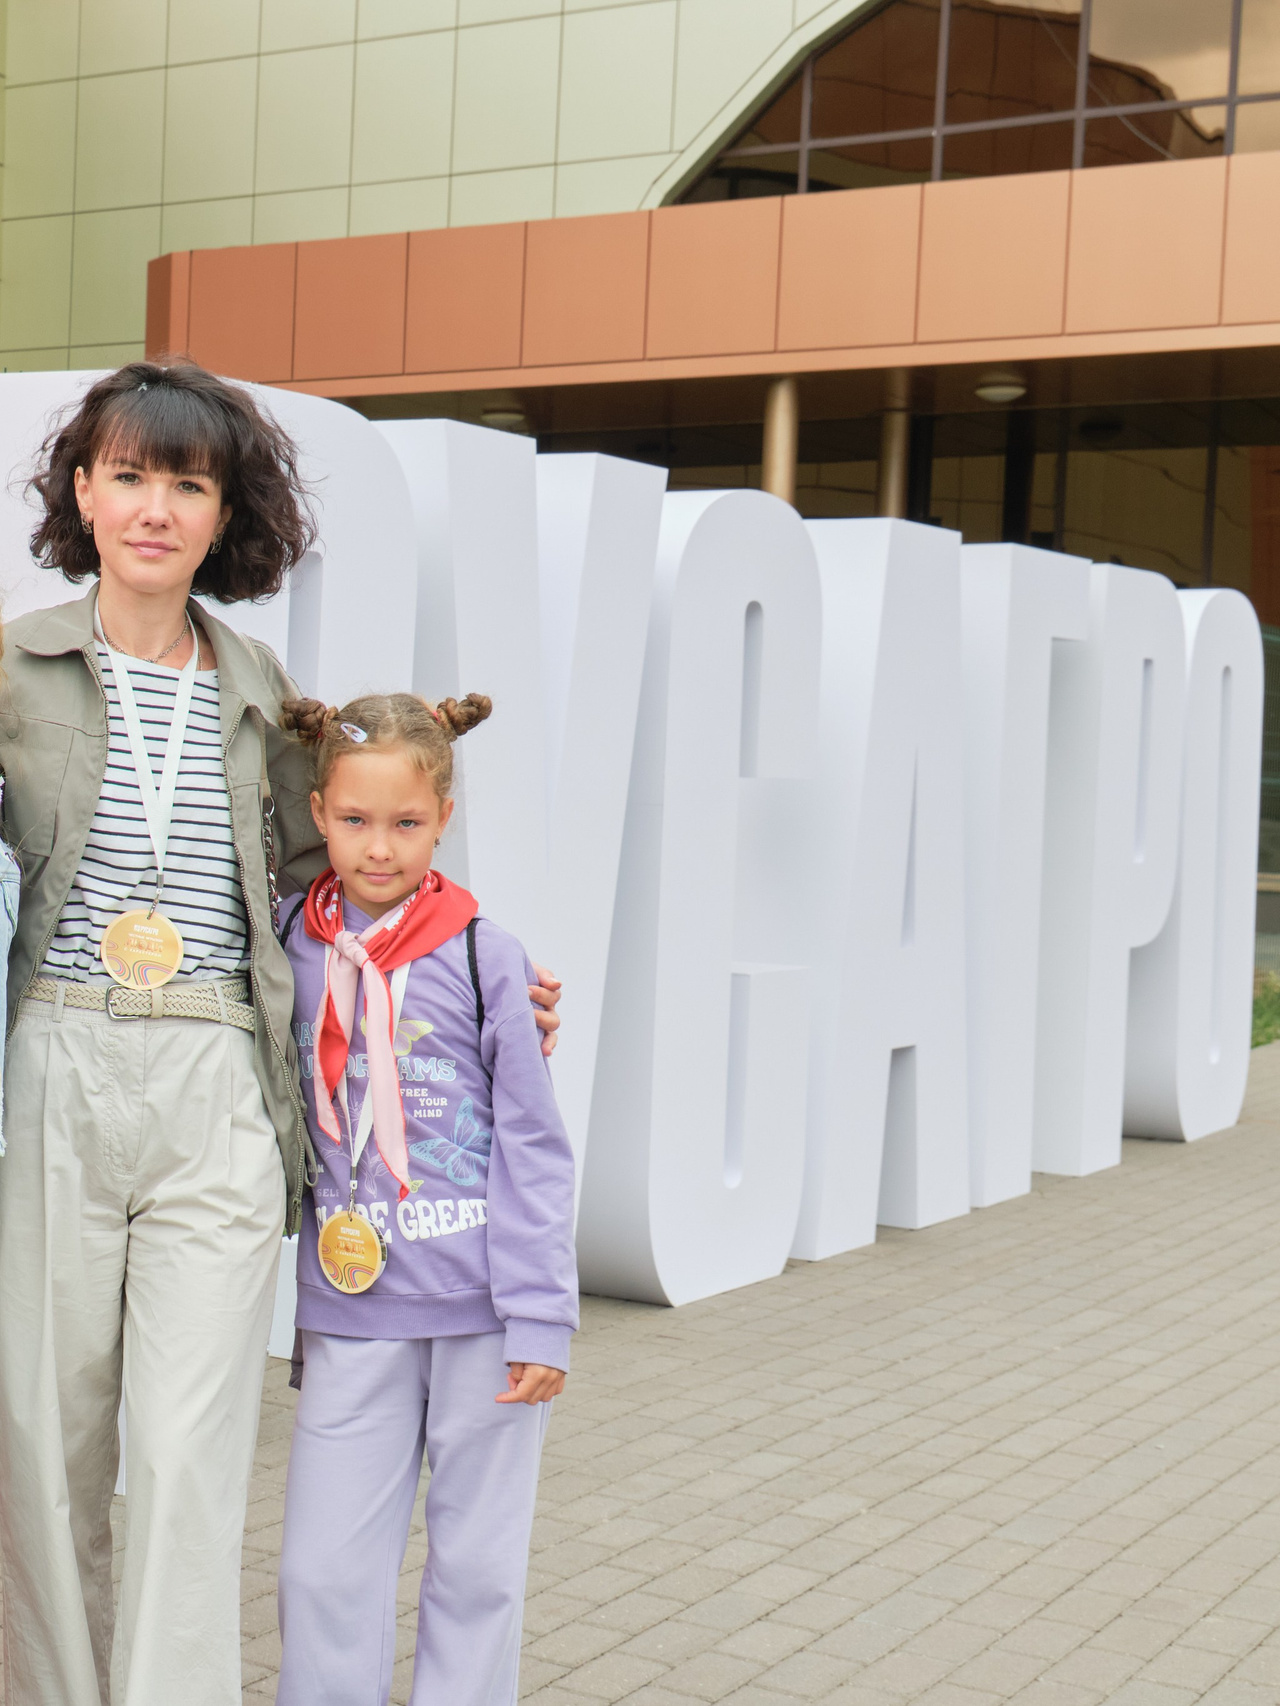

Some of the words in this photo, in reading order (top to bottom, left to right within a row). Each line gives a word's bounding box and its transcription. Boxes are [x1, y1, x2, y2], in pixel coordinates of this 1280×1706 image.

[345, 1053, 458, 1082] DRAMS
[419, 1097, 449, 1107] YOUR
[413, 1108, 443, 1118] MIND
